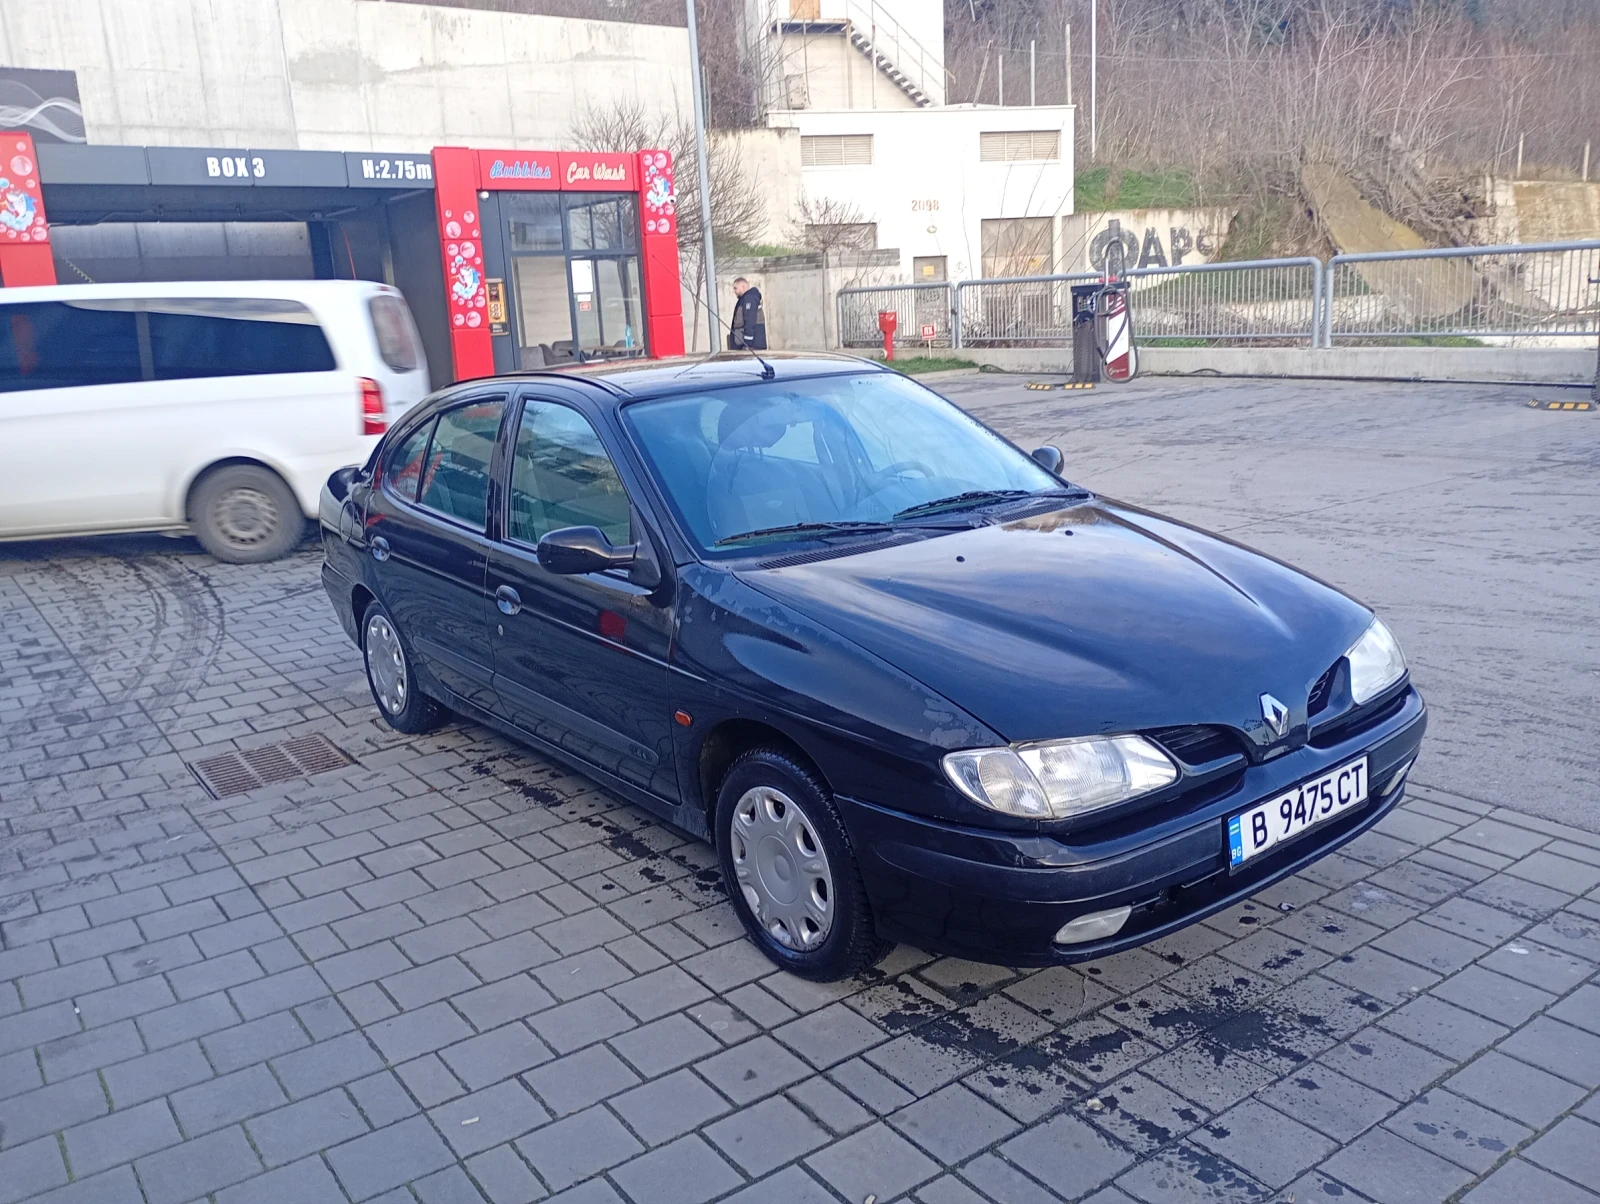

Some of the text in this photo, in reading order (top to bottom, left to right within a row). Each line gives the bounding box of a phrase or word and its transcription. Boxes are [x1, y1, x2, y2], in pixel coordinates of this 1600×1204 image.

[206, 157, 266, 178] BOX 3
[362, 159, 432, 180] H:2.75m
[490, 160, 551, 179] Bubbles
[566, 161, 626, 184] Car Wash
[911, 199, 939, 212] 2098
[1252, 763, 1363, 849] B 9475 CT
[1231, 845, 1241, 860] BG
